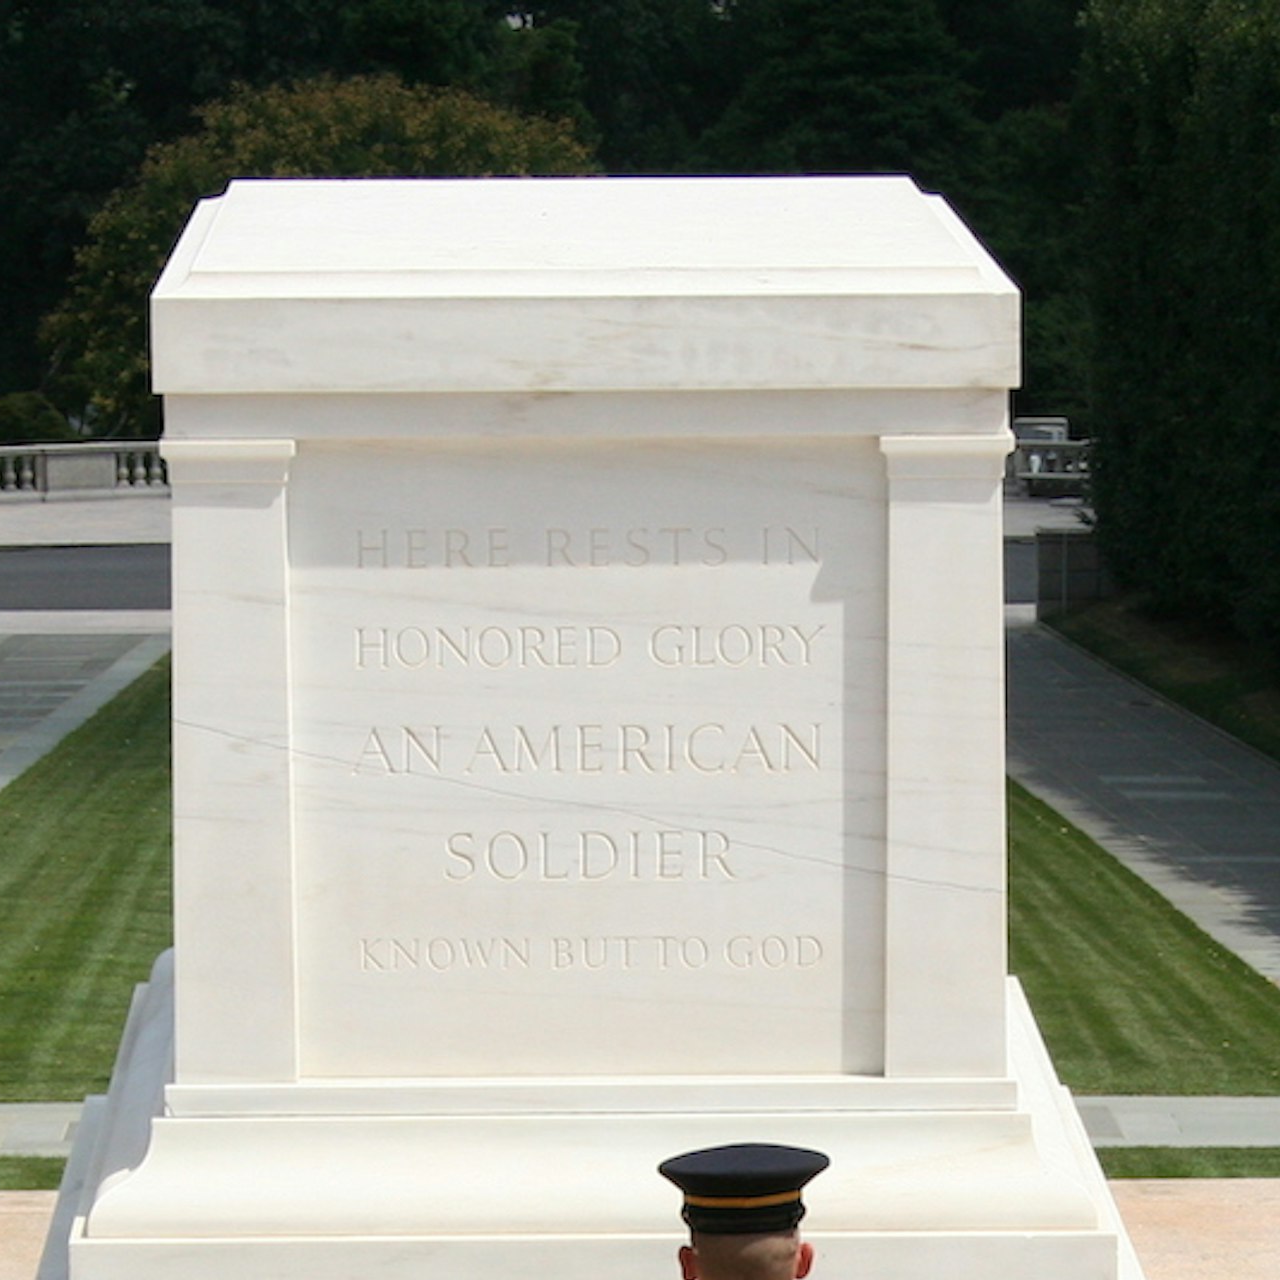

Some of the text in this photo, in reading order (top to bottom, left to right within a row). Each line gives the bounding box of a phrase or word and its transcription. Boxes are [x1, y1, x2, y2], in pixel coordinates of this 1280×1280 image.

[356, 526, 821, 568] HERE RESTS IN
[353, 623, 827, 671] HONORED GLORY
[352, 722, 823, 776] AN AMERICAN
[442, 830, 738, 883] SOLDIER
[359, 934, 824, 972] KNOWN BUT TO GOD
